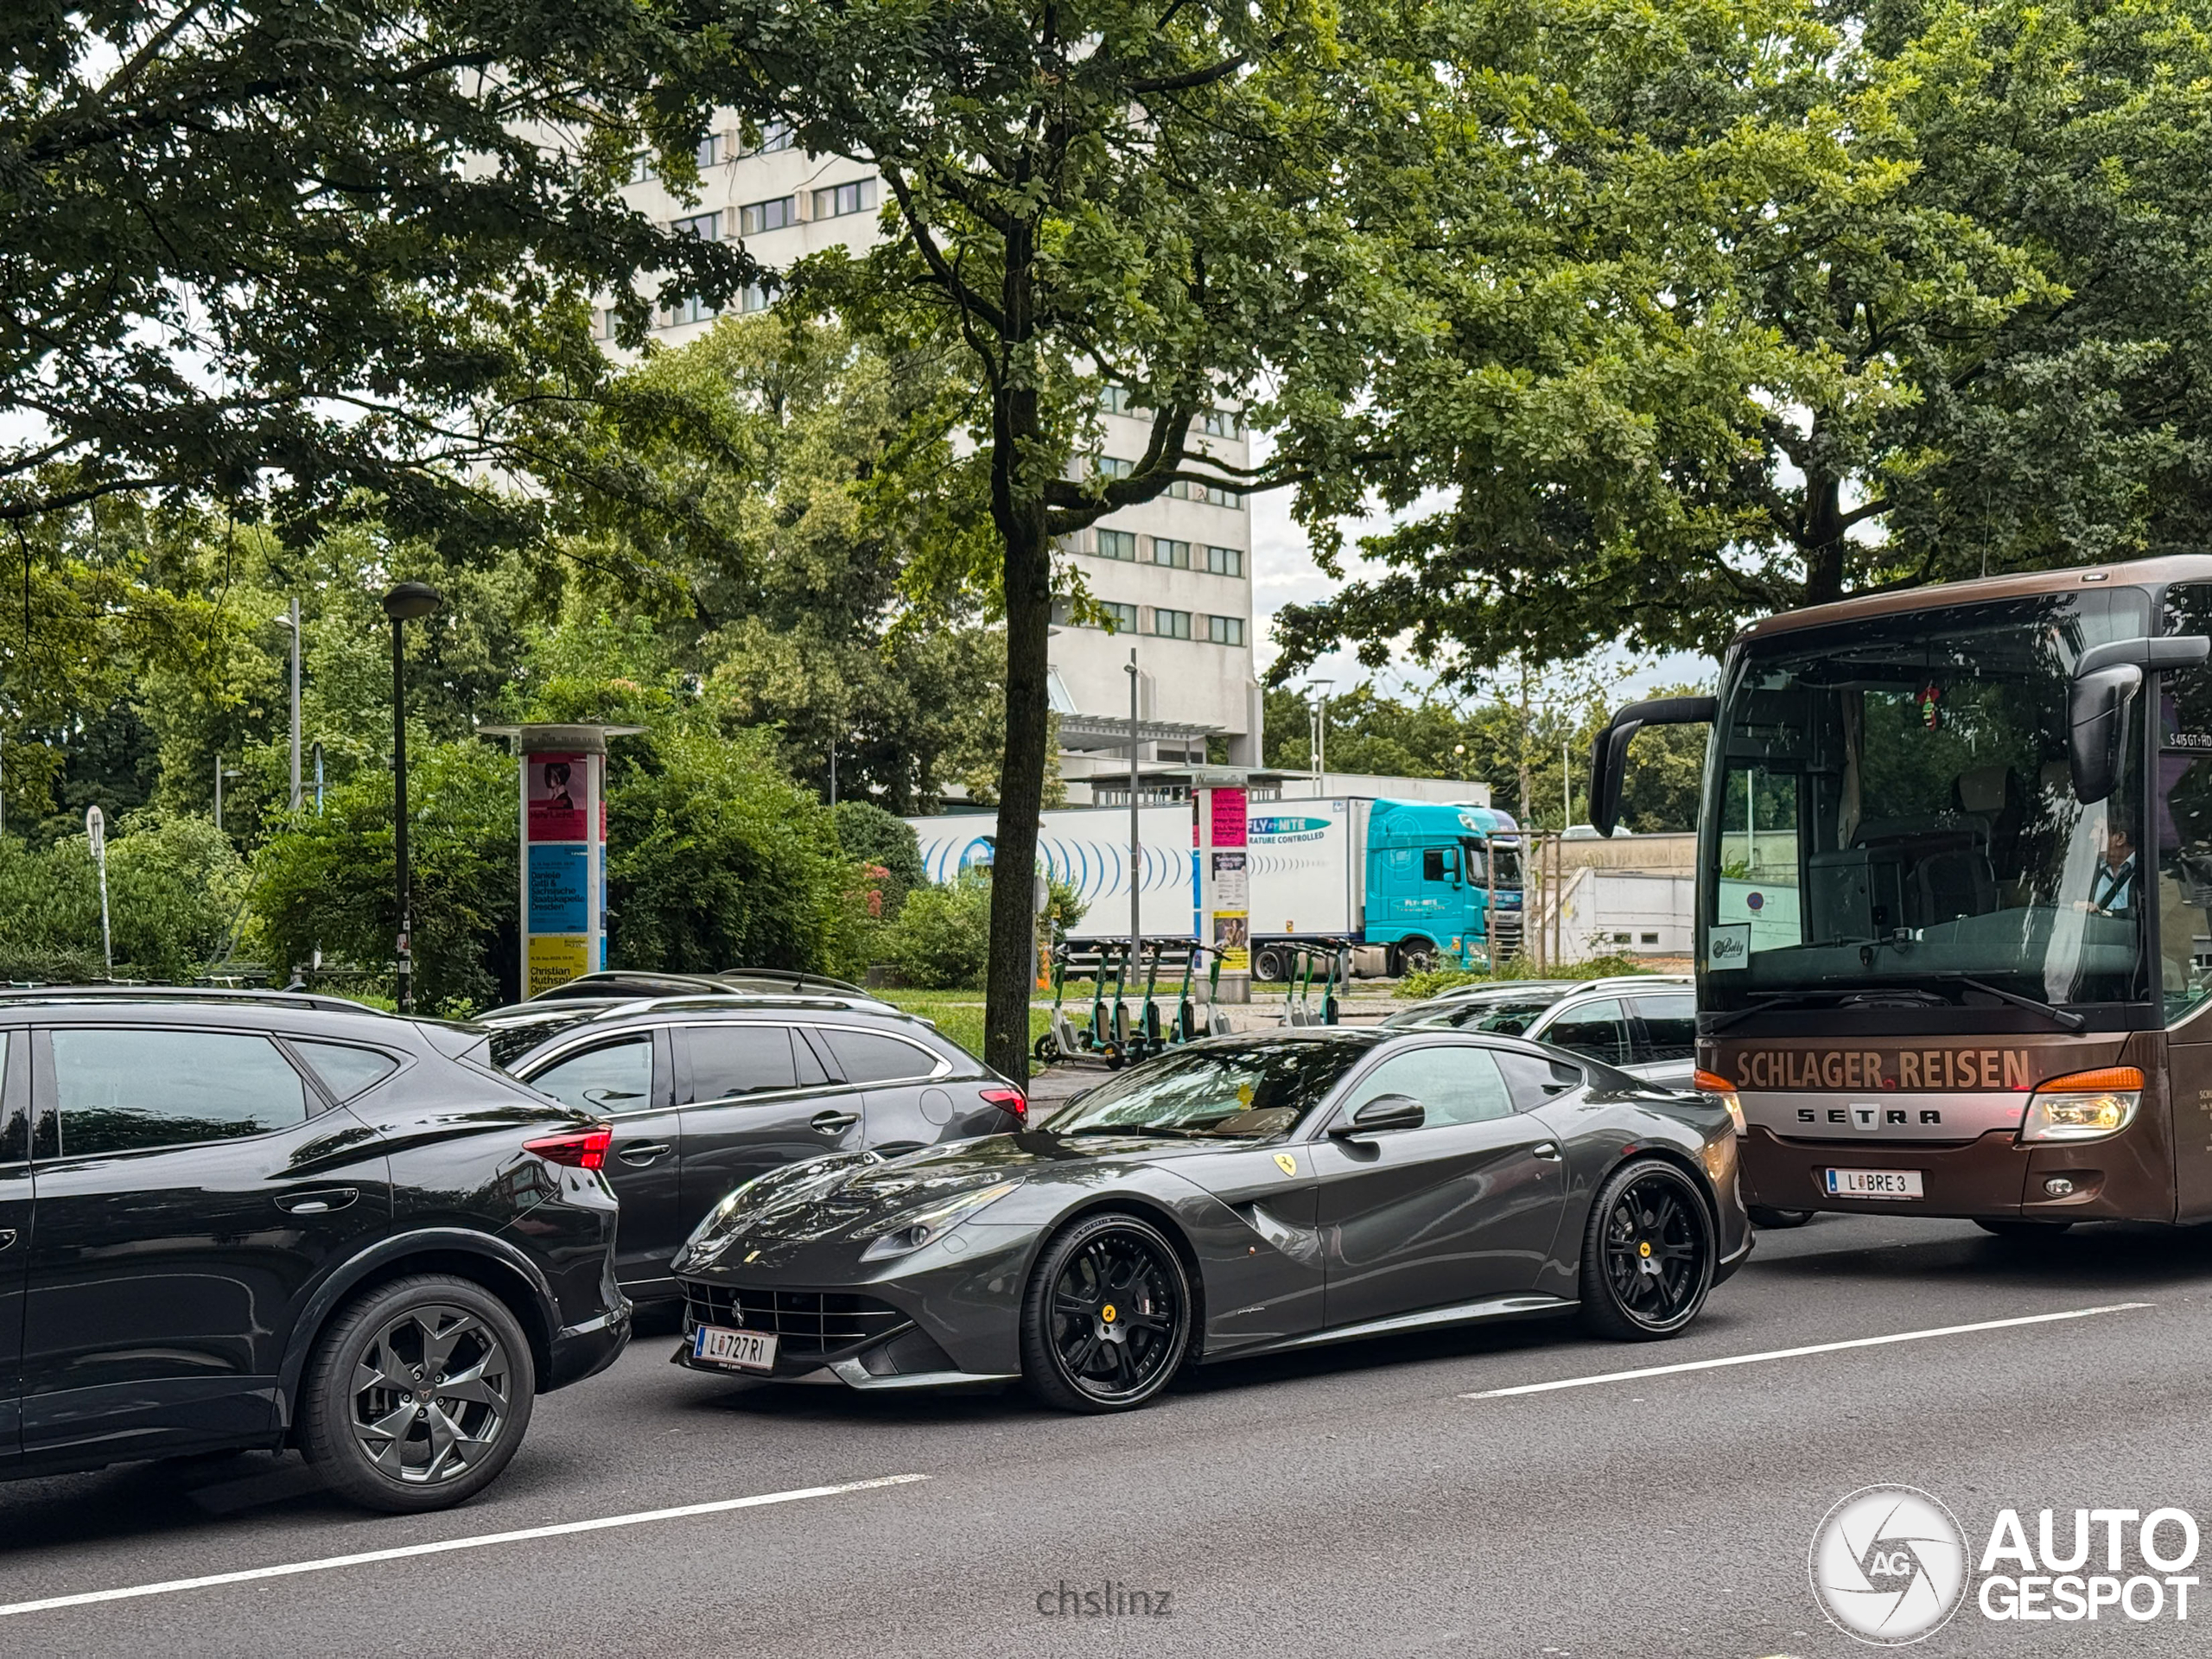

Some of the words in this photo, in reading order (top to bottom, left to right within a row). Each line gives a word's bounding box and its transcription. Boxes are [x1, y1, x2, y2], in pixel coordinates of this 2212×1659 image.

[1248, 818, 1268, 832] FLY
[1278, 818, 1306, 831] NITE
[1277, 830, 1325, 844] CONTROLLED
[531, 871, 562, 880] Daniele
[531, 894, 586, 905] Staatskapelle
[531, 901, 565, 911] Dresden
[531, 966, 571, 976] Christian
[531, 976, 577, 985] Muthspi
[1737, 1051, 1885, 1088] SCHLAGER
[1899, 1049, 2031, 1088] REISEN
[1797, 1109, 1942, 1125] SETRA
[1848, 1173, 1856, 1190] L
[709, 1332, 715, 1355] L
